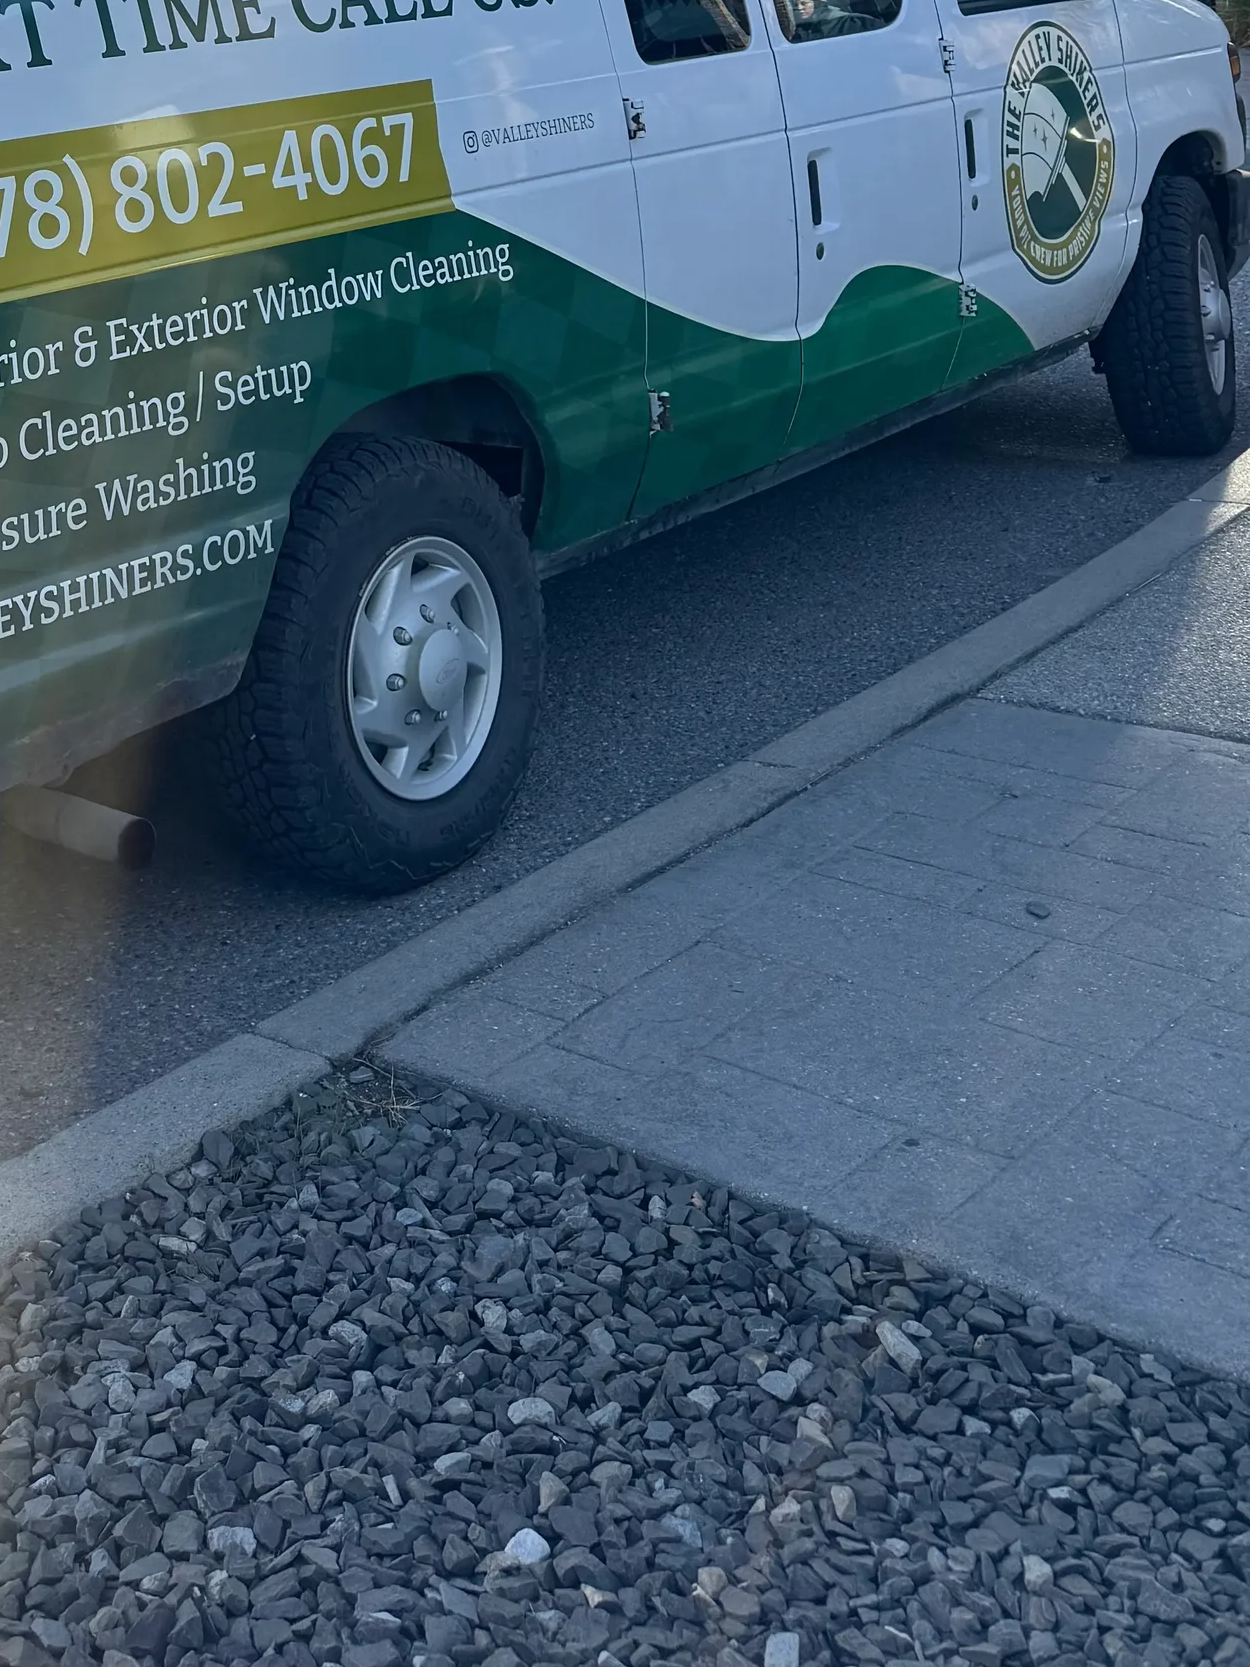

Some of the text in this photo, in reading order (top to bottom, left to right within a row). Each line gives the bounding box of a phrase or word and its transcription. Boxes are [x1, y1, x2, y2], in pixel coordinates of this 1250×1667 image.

[481, 113, 595, 147] @VALLEYSHINERS
[1005, 31, 1105, 158] THE VALLEY SHINERS
[112, 111, 417, 235] 802-4067
[1010, 184, 1025, 227] YOUR
[1030, 243, 1051, 267] CREW
[1053, 247, 1068, 267] FOR
[1068, 208, 1096, 263] PRISTINE
[1093, 160, 1109, 210] VIEWS
[74, 326, 99, 368] &
[108, 296, 249, 363] Exterior
[253, 267, 385, 327] Window
[389, 240, 515, 294] Cleaning
[18, 387, 187, 460] Cleaning
[214, 359, 313, 413] Setup
[95, 449, 258, 523] Washing
